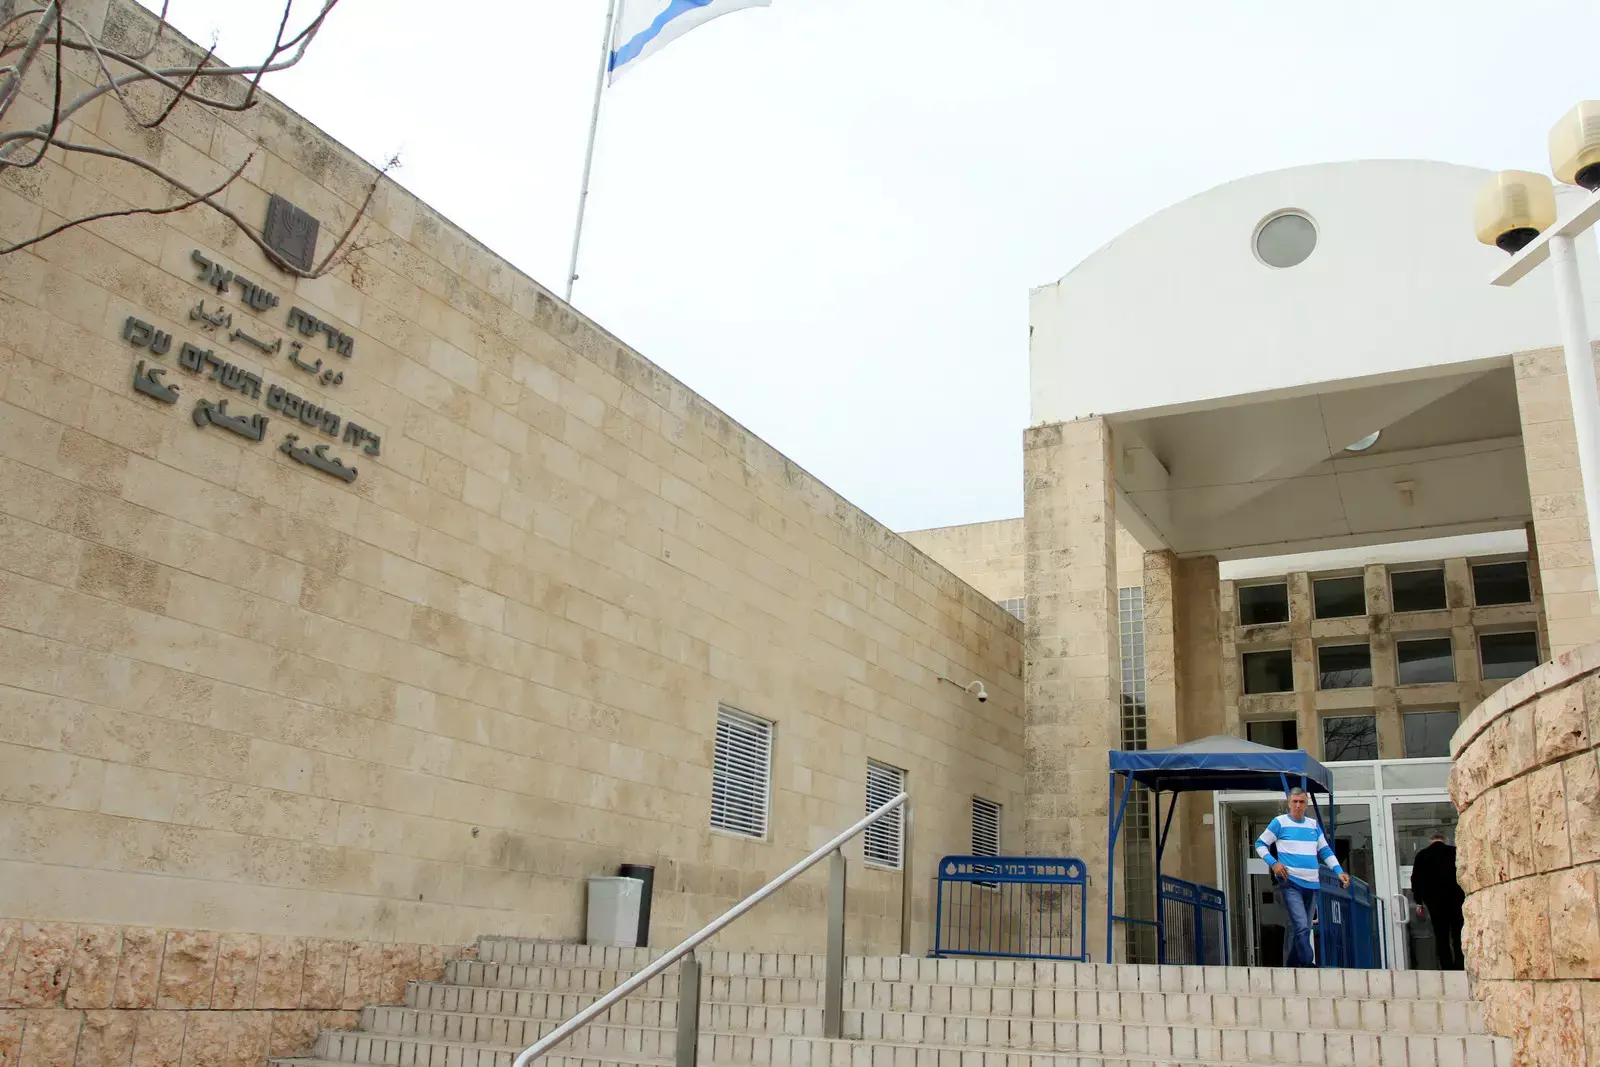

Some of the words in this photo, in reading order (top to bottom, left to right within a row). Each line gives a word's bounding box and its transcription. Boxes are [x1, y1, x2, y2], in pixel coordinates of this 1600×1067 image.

[192, 249, 279, 312] ישראל
[123, 316, 172, 355] עכו
[287, 306, 354, 358] מדינת
[134, 360, 180, 404] عكا
[180, 341, 263, 399] השלום
[192, 398, 270, 441] الصلح
[266, 384, 341, 437] משפט
[279, 433, 359, 484] محكمة
[343, 421, 381, 456] בית
